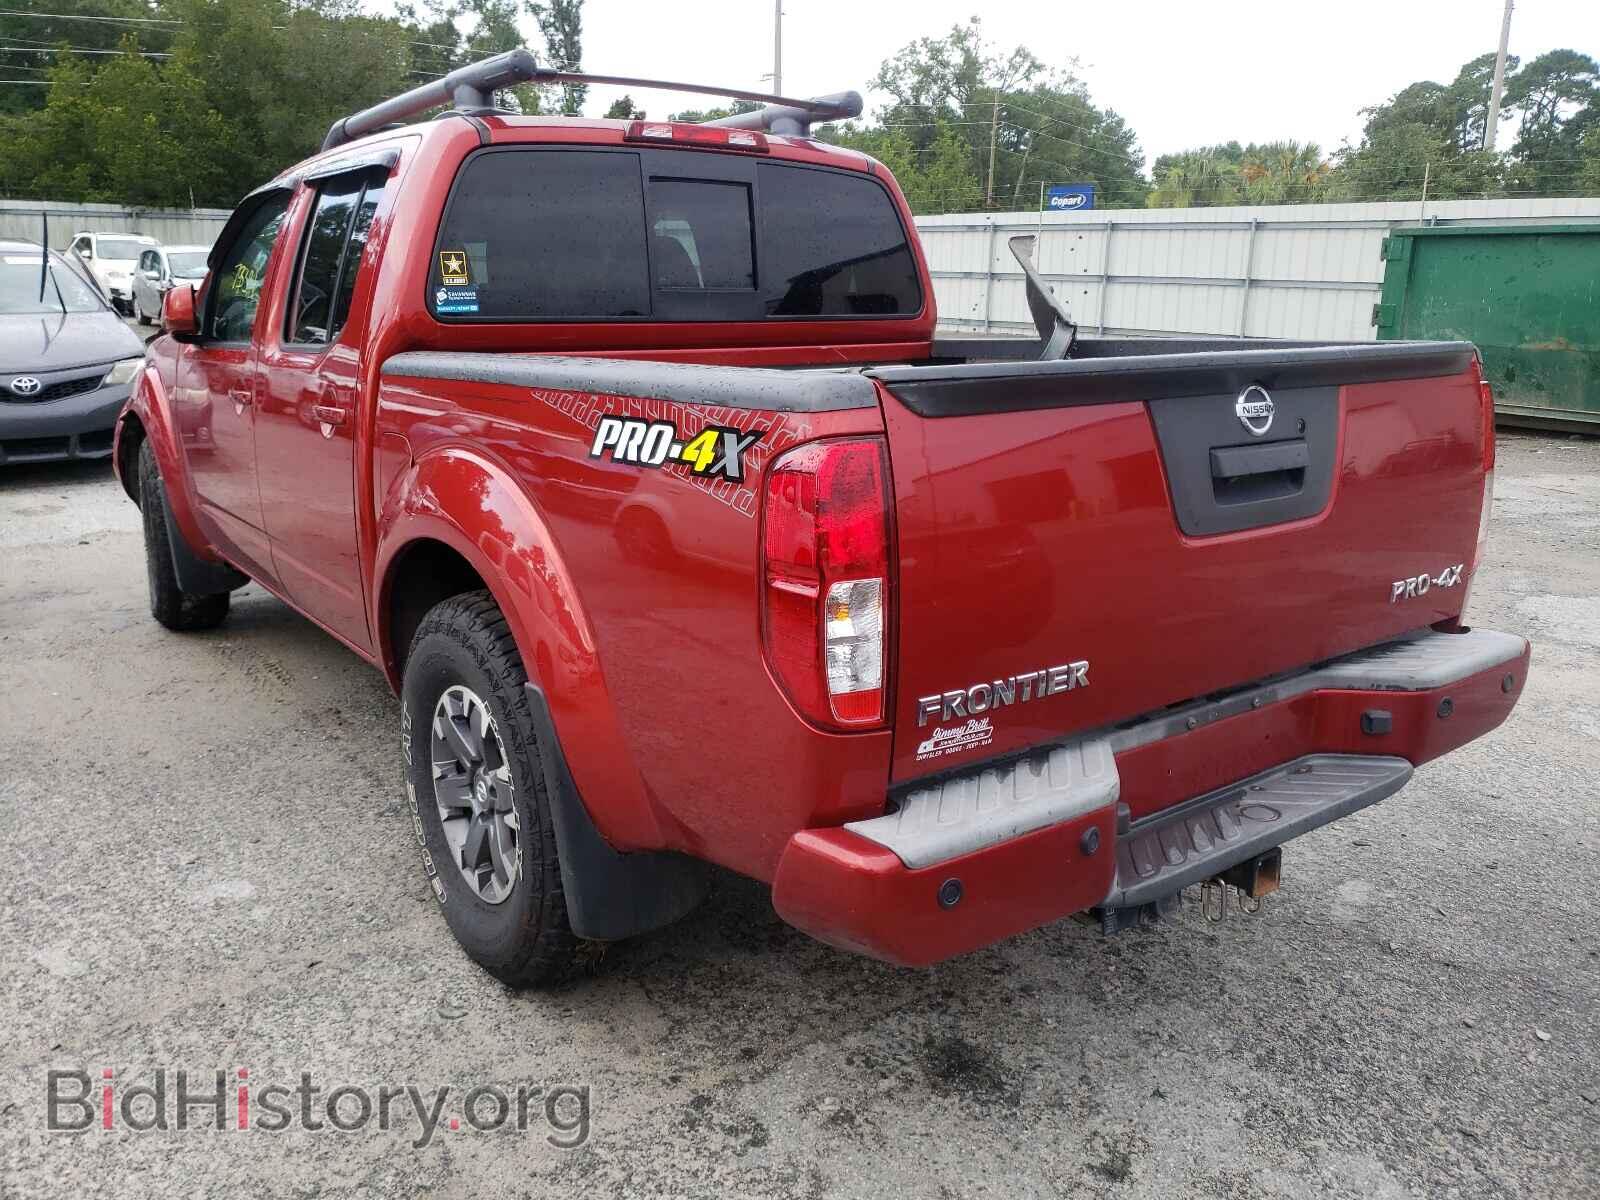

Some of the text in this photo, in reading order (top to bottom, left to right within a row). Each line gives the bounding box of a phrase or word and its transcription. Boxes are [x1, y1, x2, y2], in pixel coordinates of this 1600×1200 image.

[1051, 196, 1082, 207] Copart
[1241, 403, 1274, 415] NISSAN
[590, 415, 762, 482] PRO-4X
[1390, 563, 1464, 602] PRO-4X
[918, 660, 1090, 727] FRONTIER
[932, 725, 967, 740] Jimmy
